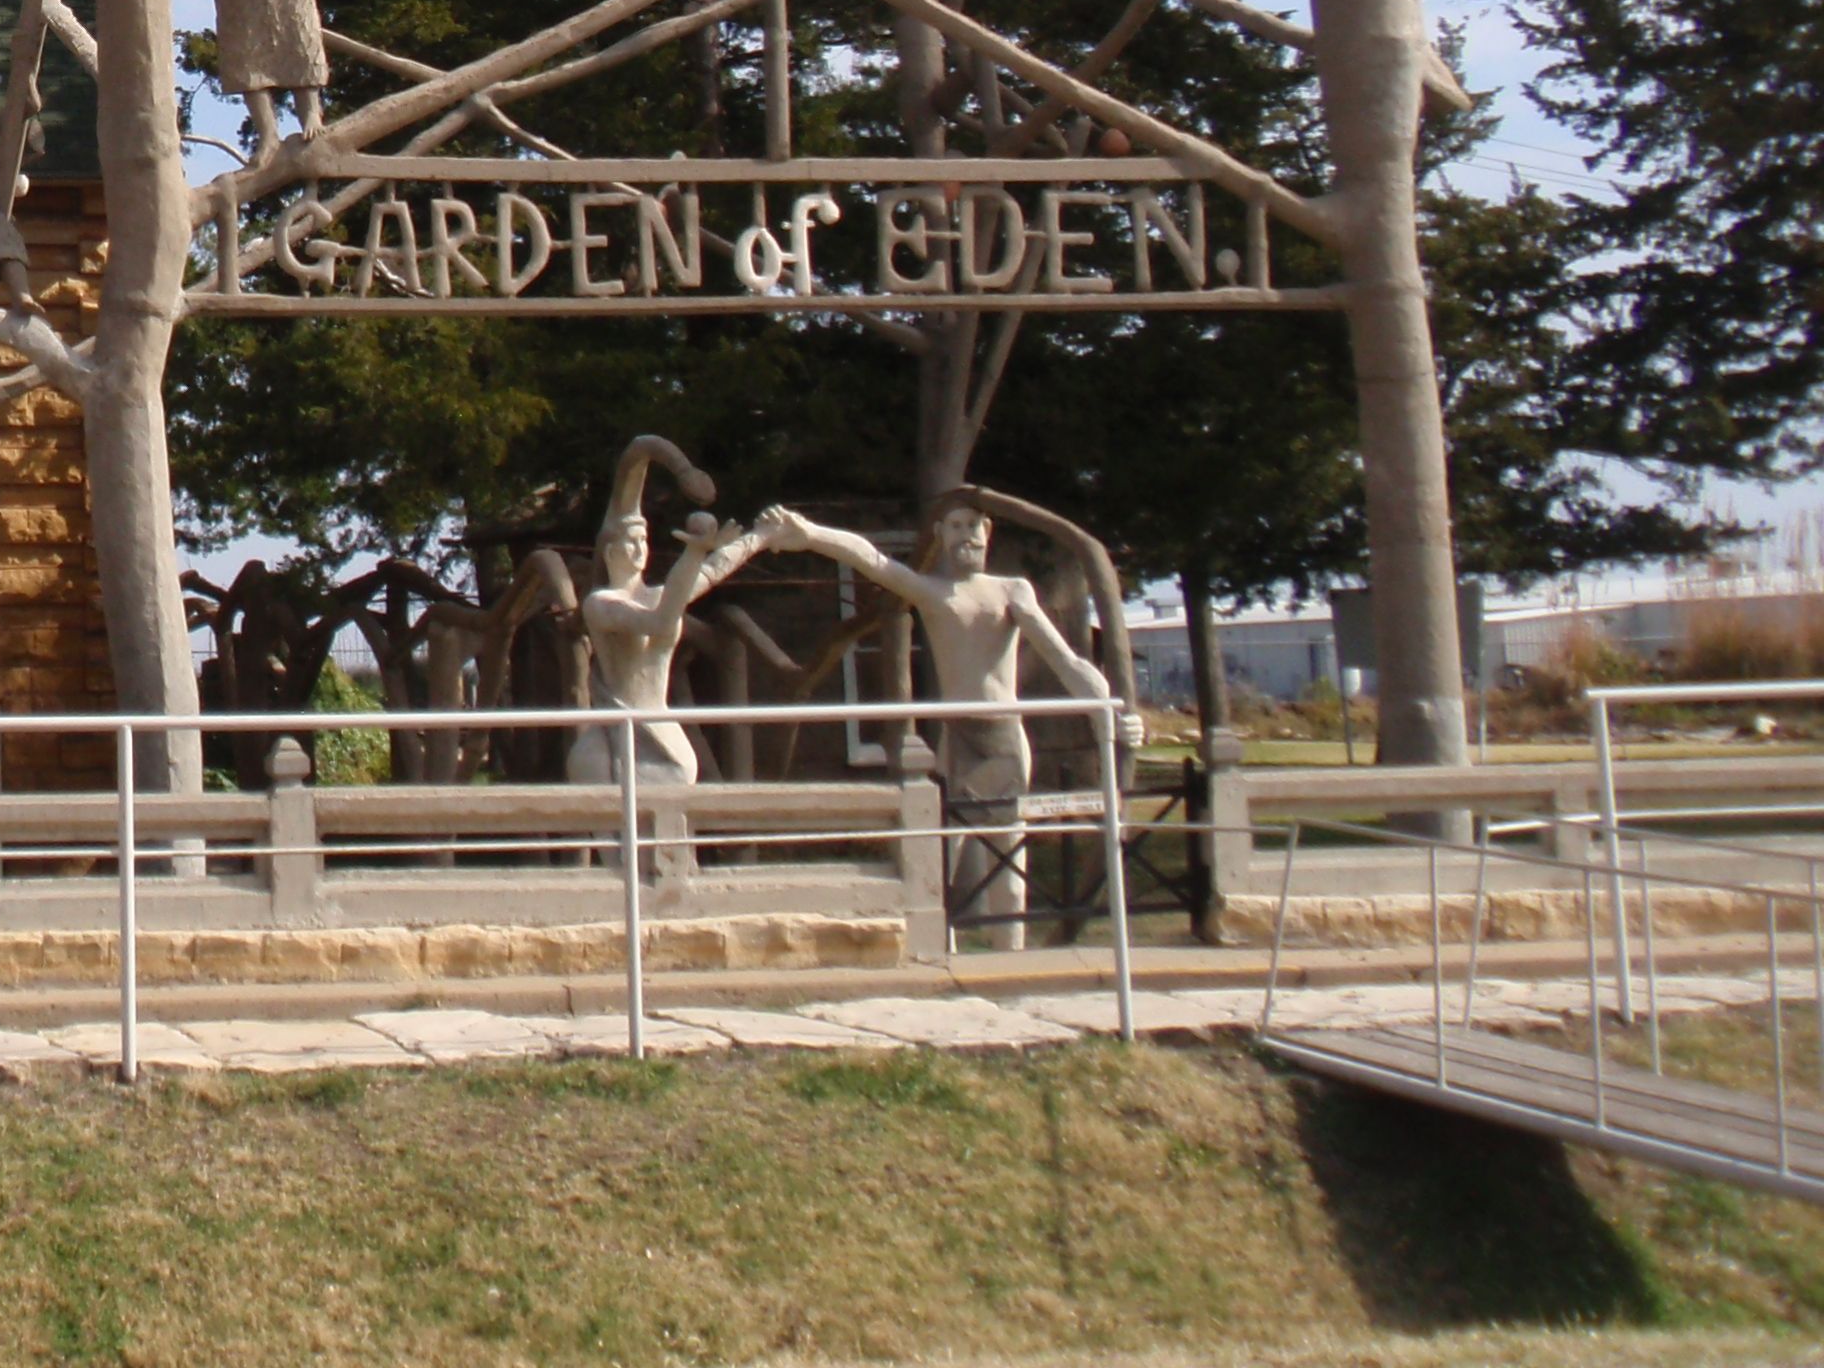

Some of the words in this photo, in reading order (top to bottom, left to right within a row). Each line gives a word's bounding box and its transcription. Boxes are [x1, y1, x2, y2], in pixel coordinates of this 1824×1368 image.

[273, 193, 703, 297] GARDEN
[734, 194, 841, 295] of
[877, 186, 1241, 293] EDEN.
